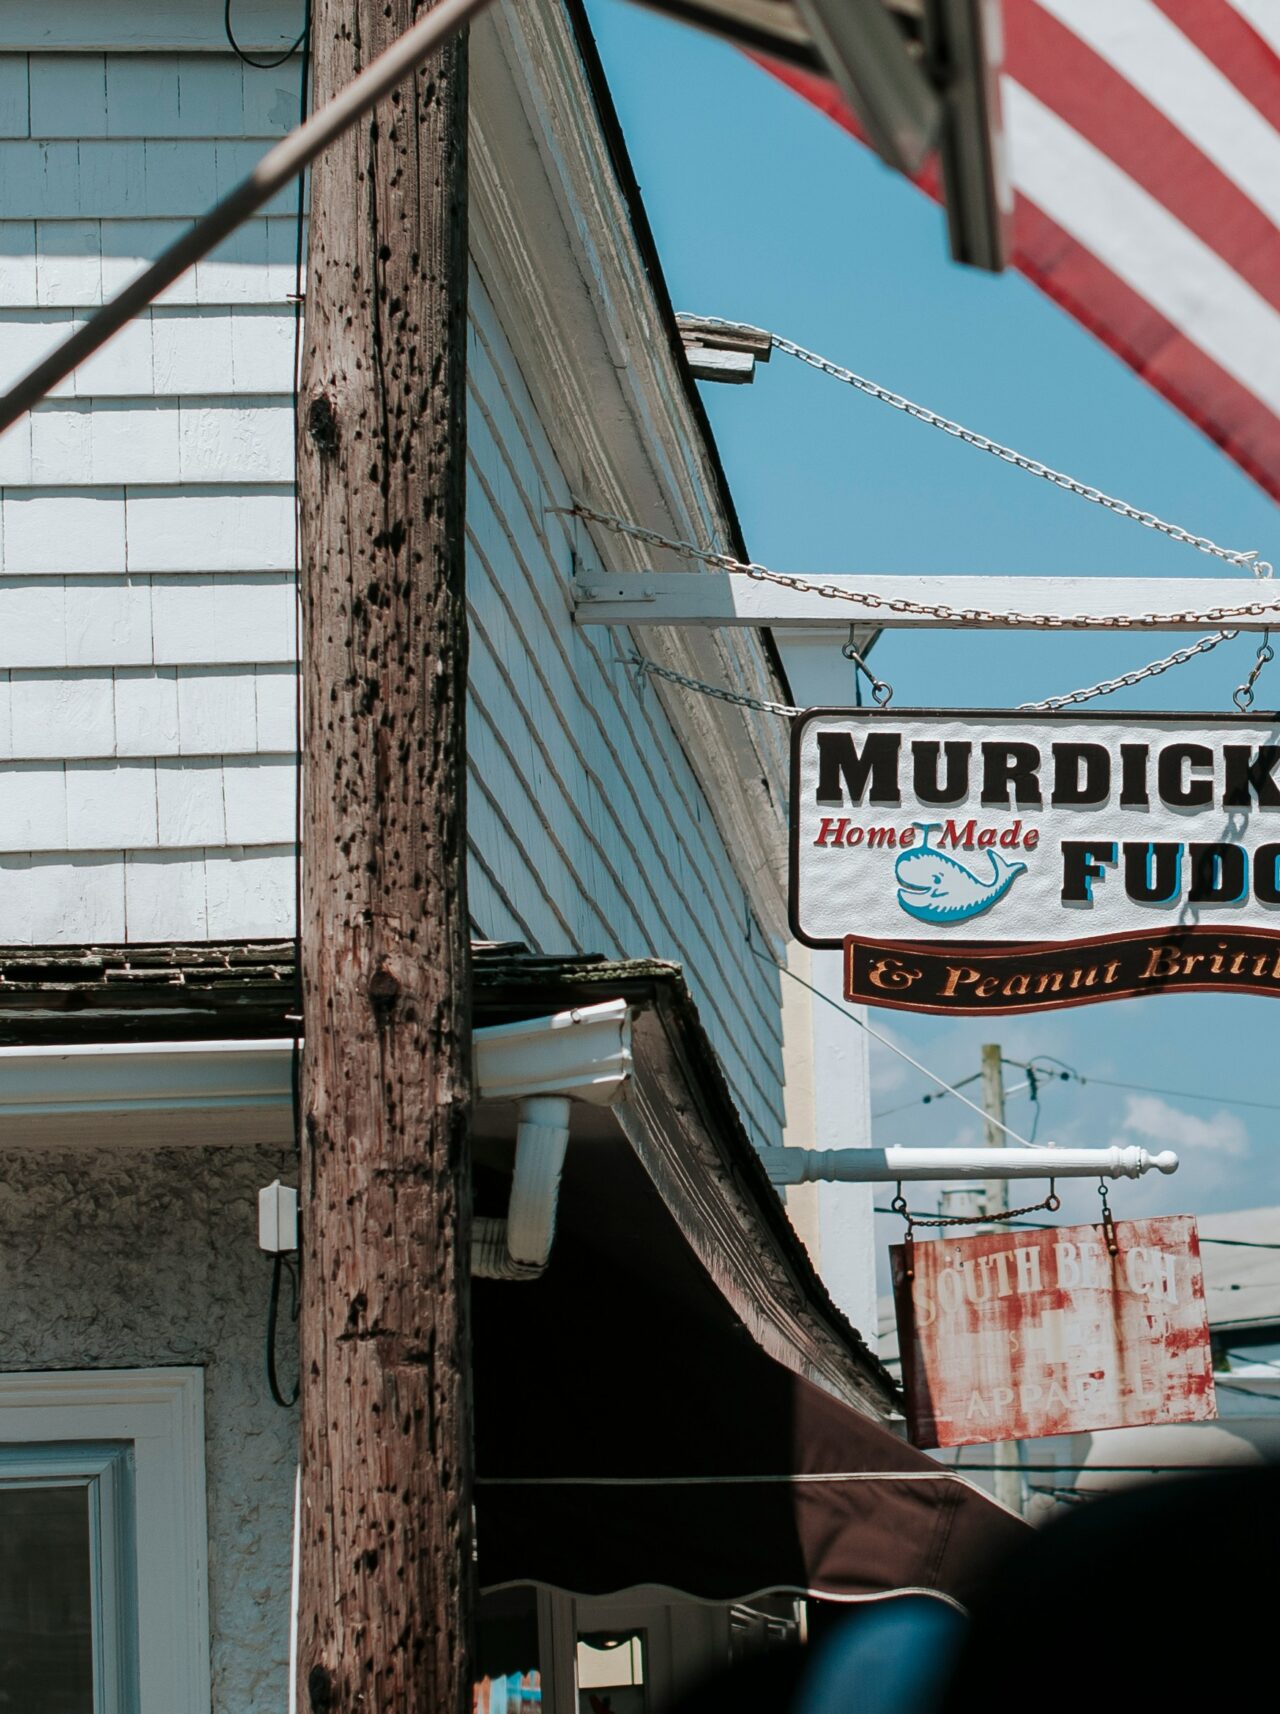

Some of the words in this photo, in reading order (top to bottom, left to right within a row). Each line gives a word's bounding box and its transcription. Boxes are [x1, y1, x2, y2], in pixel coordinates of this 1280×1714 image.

[814, 818, 916, 848] Home
[937, 820, 1039, 849] Made
[869, 959, 922, 990] &
[937, 959, 1122, 997] Peanut
[912, 1245, 1043, 1327] SOUTH
